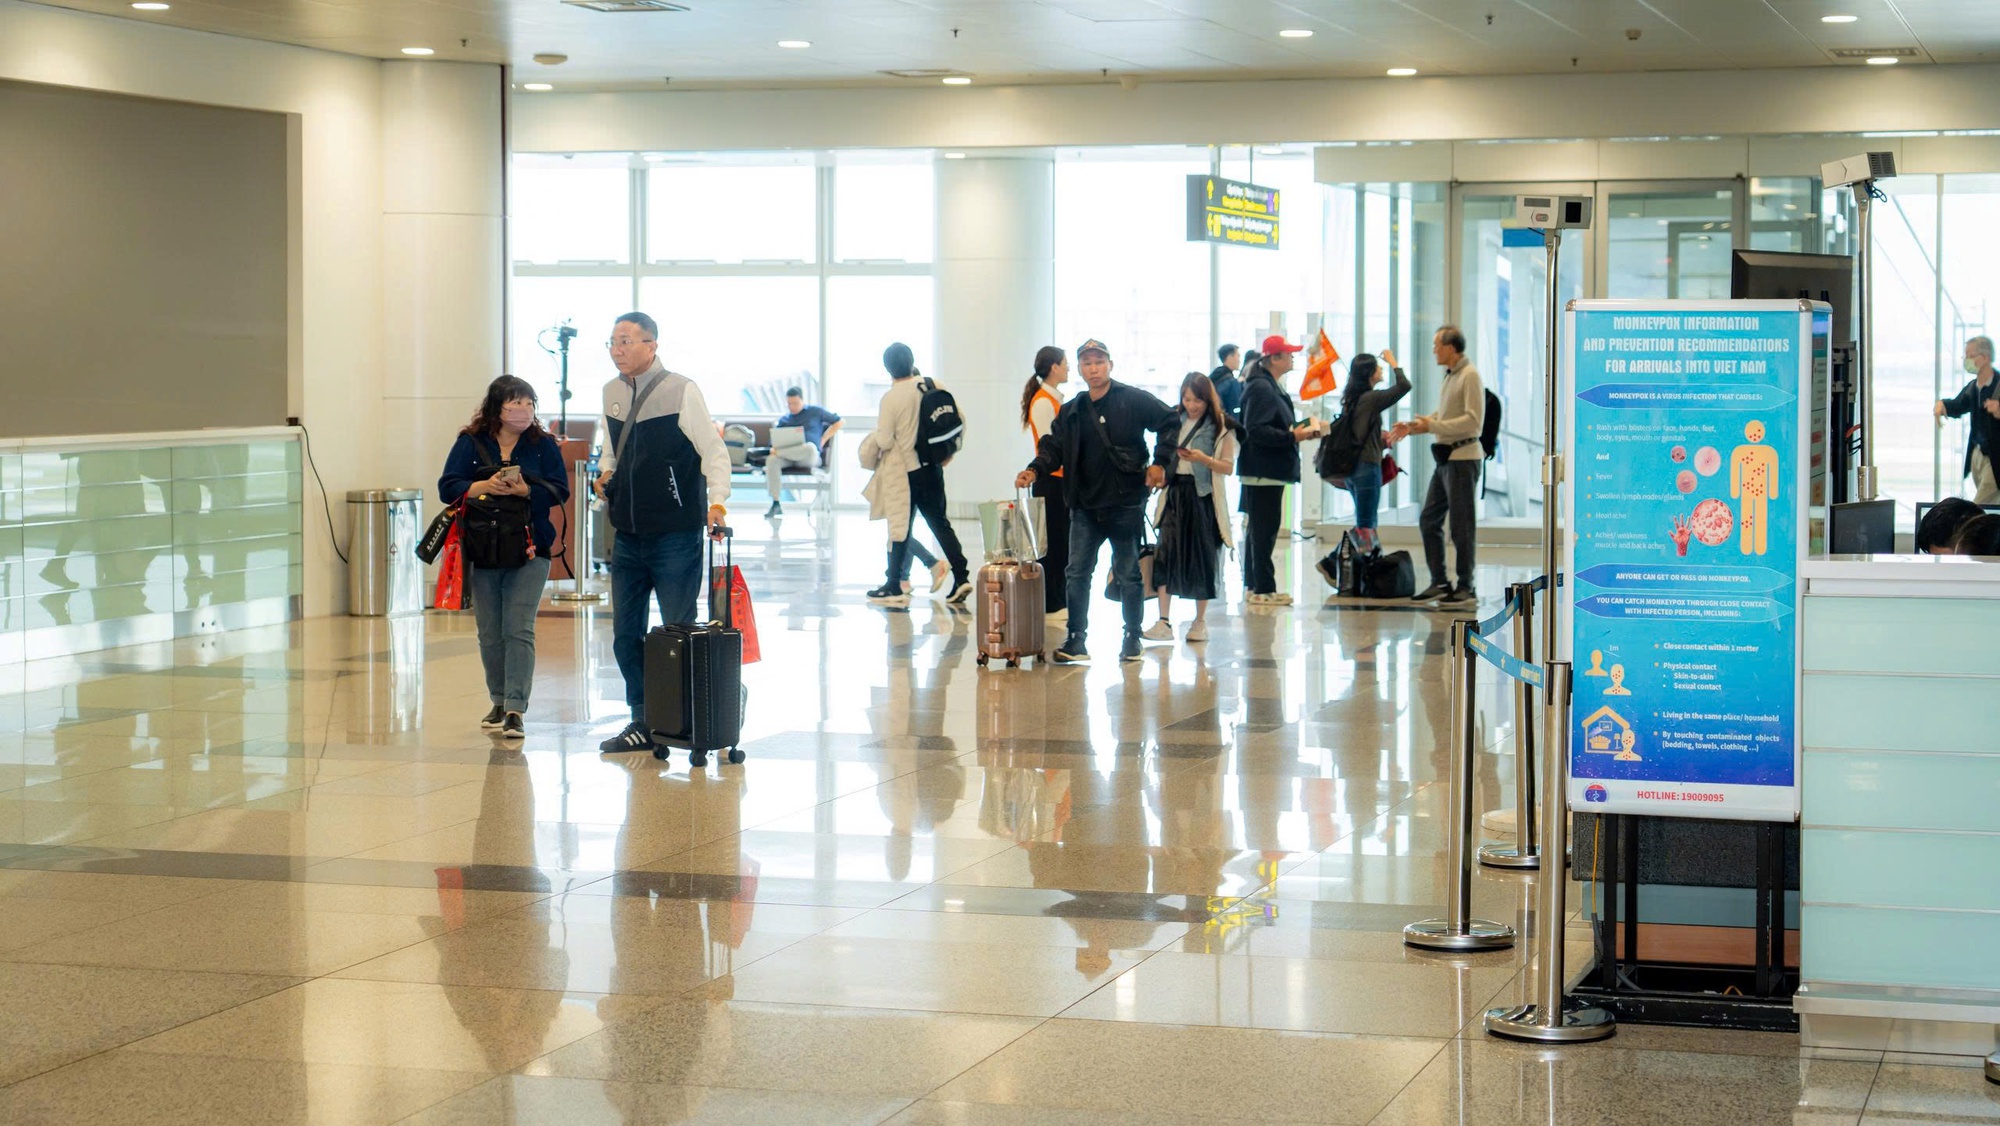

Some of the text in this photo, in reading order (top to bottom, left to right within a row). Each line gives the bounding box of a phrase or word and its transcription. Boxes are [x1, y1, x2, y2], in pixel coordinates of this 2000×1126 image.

[1614, 316, 1759, 330] MONKEYPOX INFORMATION
[1584, 338, 1790, 352] AND PREVENTION RECOMMENDATIONS
[1606, 360, 1766, 374] FOR ARRIVALS INTO VIET NAM
[1608, 392, 1648, 400] MONKEYPOX
[1596, 434, 1614, 442] body,
[1621, 493, 1641, 501] lymph
[1674, 609, 1703, 617] PERSON,
[1664, 642, 1681, 650] Close
[1708, 643, 1730, 651] within
[1663, 662, 1691, 670] Physical
[1674, 672, 1714, 680] Skin-to-skin
[1674, 682, 1696, 690] Sexual
[1662, 711, 1683, 720] Living
[1662, 731, 1671, 739] By
[1674, 732, 1703, 740] touching
[1755, 734, 1780, 743] objects
[1662, 740, 1694, 750] (bedding,
[1695, 742, 1719, 750] towels,
[1720, 743, 1748, 752] clothing
[1637, 791, 1724, 802] HOTLINE: 19009095
